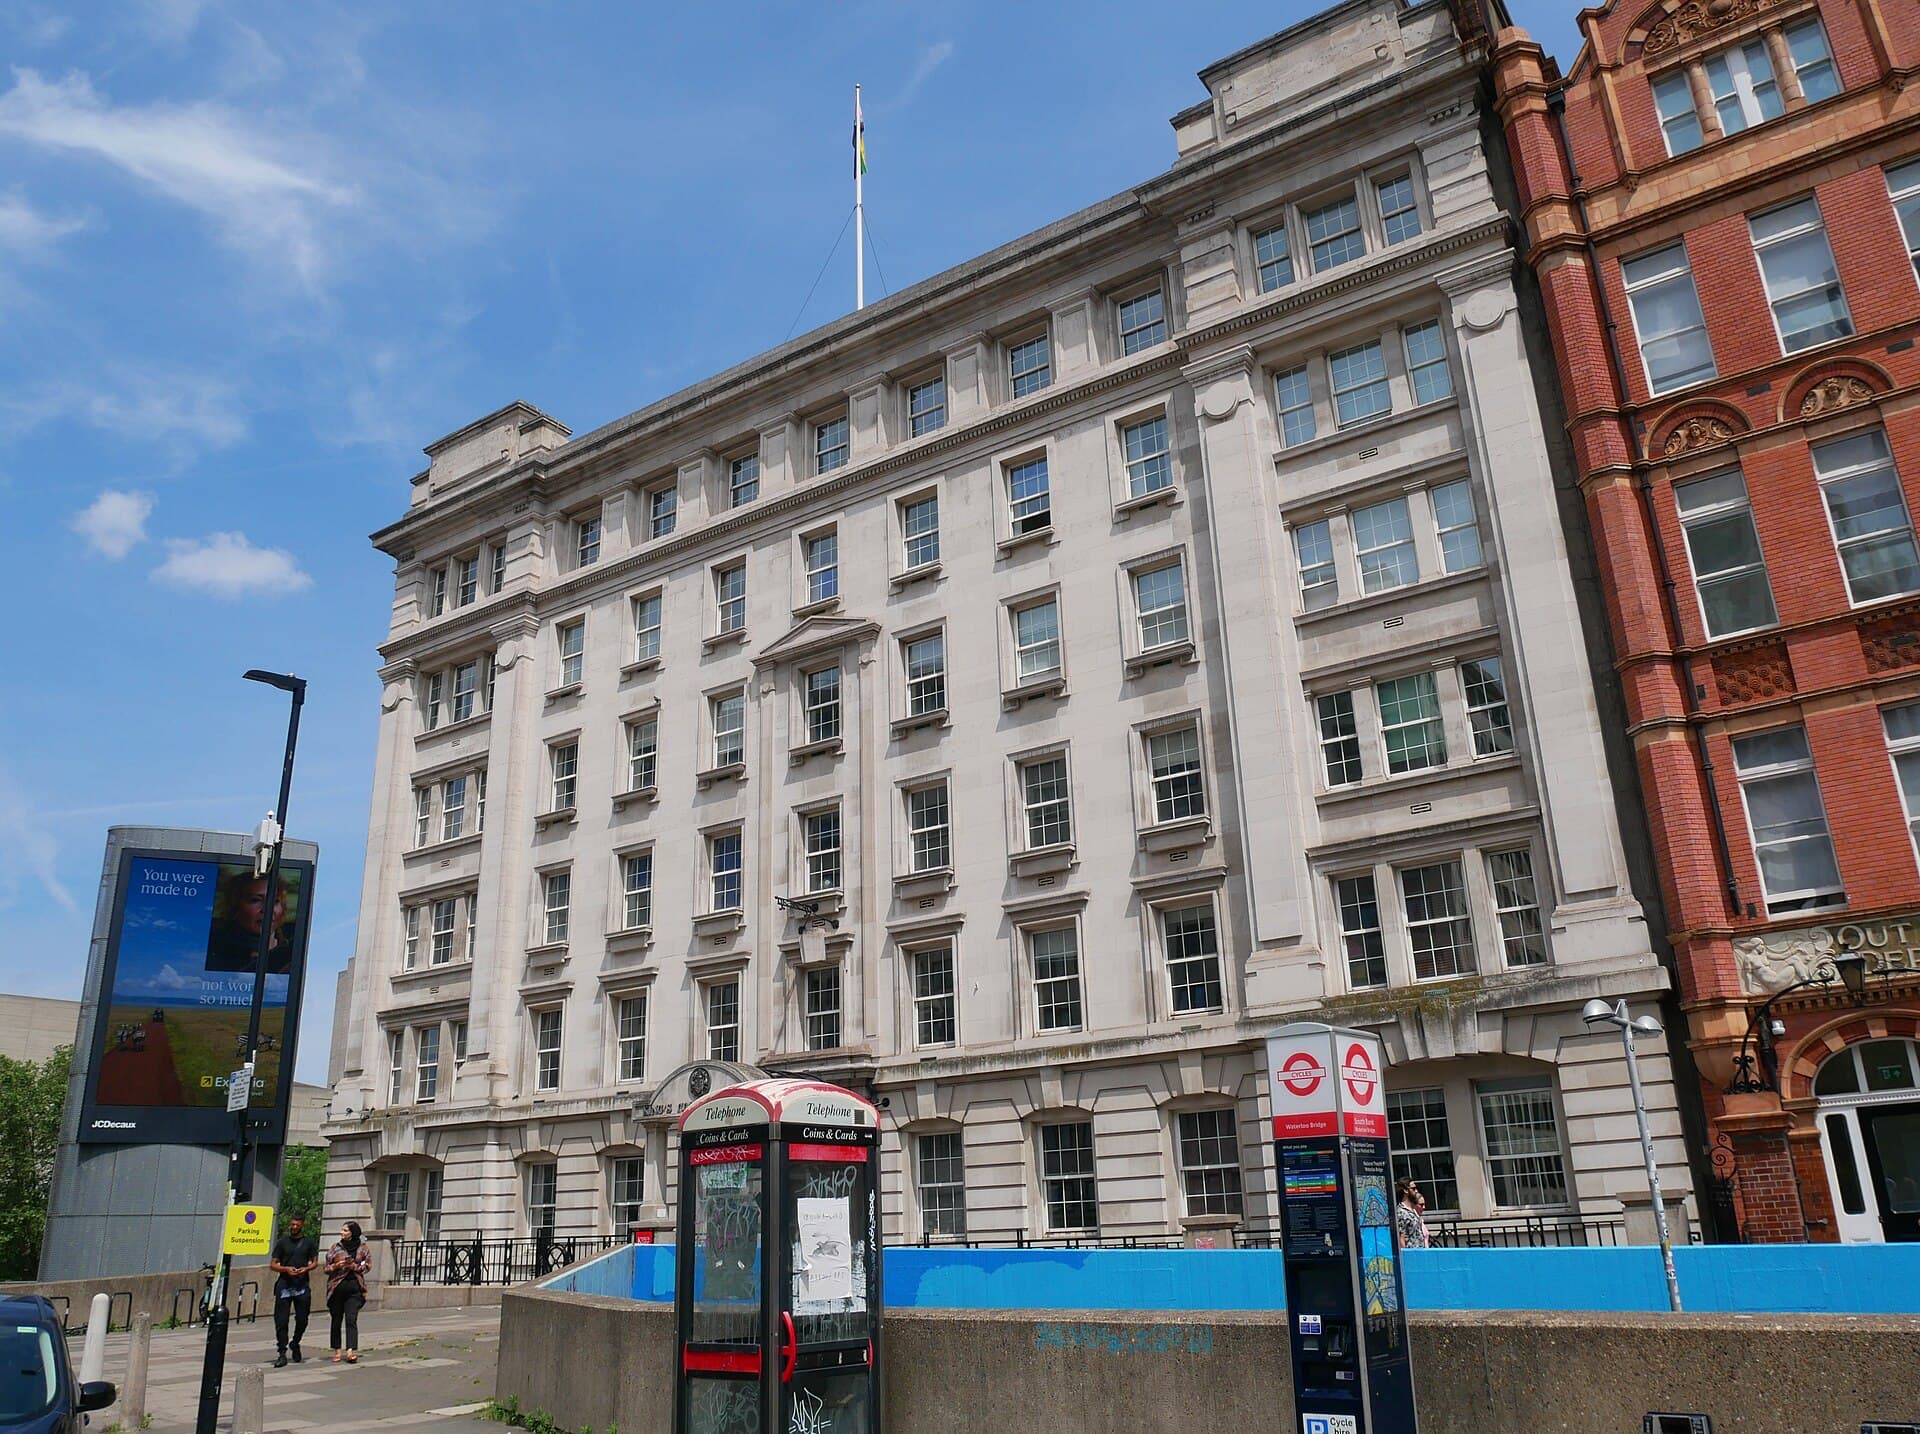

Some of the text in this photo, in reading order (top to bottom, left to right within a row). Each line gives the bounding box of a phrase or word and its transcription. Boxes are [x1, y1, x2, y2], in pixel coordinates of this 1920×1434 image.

[143, 868, 206, 884] You were
[140, 883, 198, 897] made to
[201, 981, 255, 992] not wor
[200, 994, 216, 1005] so
[1291, 1070, 1312, 1078] CYCLES
[215, 1076, 265, 1088] Exia
[705, 1105, 746, 1121] Telephone
[807, 1102, 852, 1118] Telephone
[91, 1120, 136, 1129] JCDecaux
[1285, 1121, 1327, 1130] Waterloo Bridge
[700, 1128, 749, 1144] Coins & Cards
[803, 1127, 857, 1141] Coins & Cards
[237, 1227, 260, 1235] Parking
[230, 1236, 265, 1244] Suspension
[1330, 1416, 1353, 1428] Cycle
